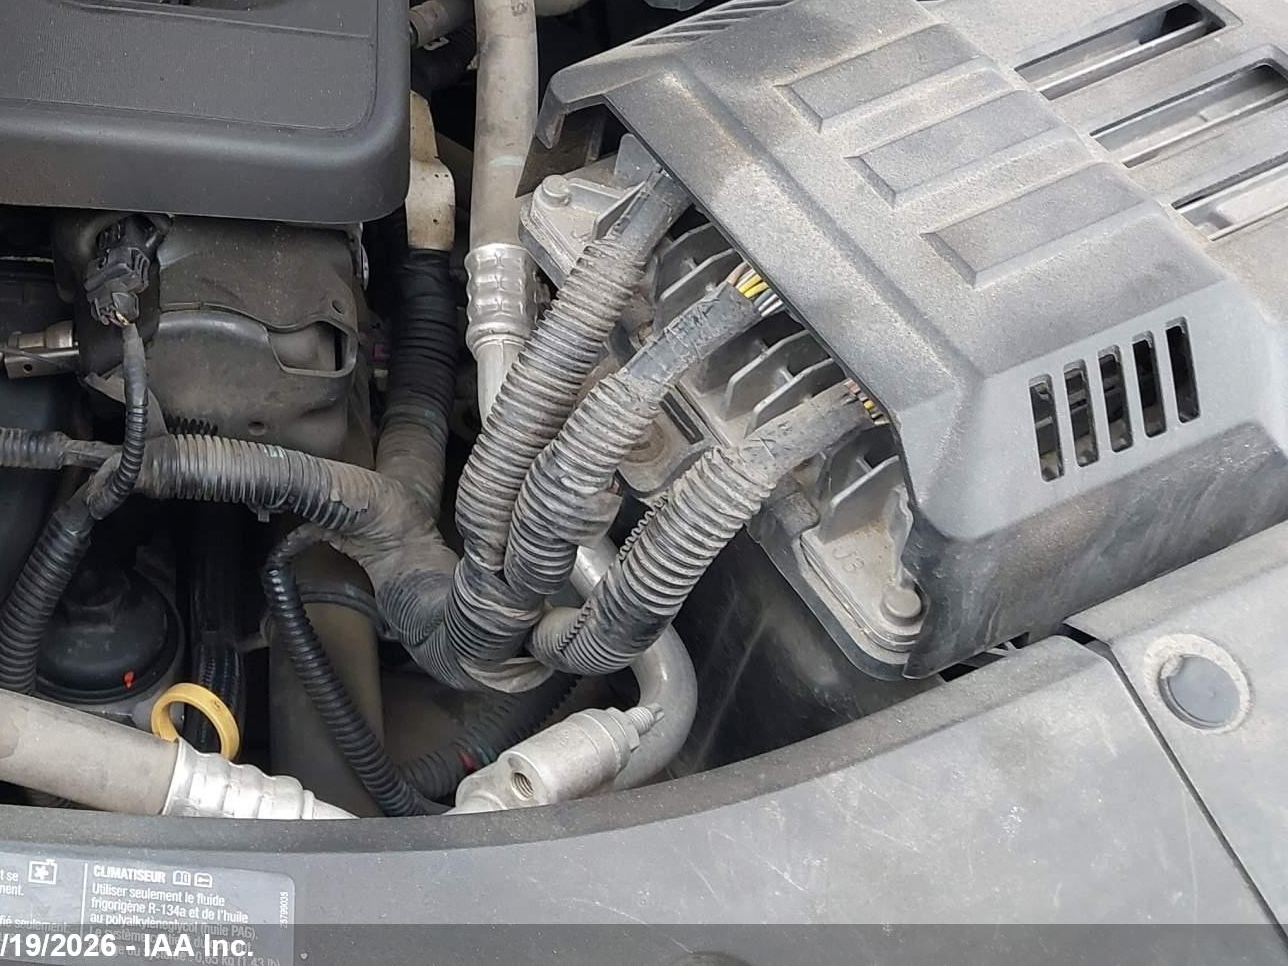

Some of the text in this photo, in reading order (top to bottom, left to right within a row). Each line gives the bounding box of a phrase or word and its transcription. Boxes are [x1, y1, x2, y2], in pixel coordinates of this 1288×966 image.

[6, 872, 17, 881] se
[93, 865, 166, 883] CLIMATISEUR
[92, 883, 225, 907] Utiliser seulement le fluide
[90, 914, 103, 923] au
[148, 903, 186, 918] R-134a
[189, 908, 199, 919] et
[202, 908, 215, 920] de
